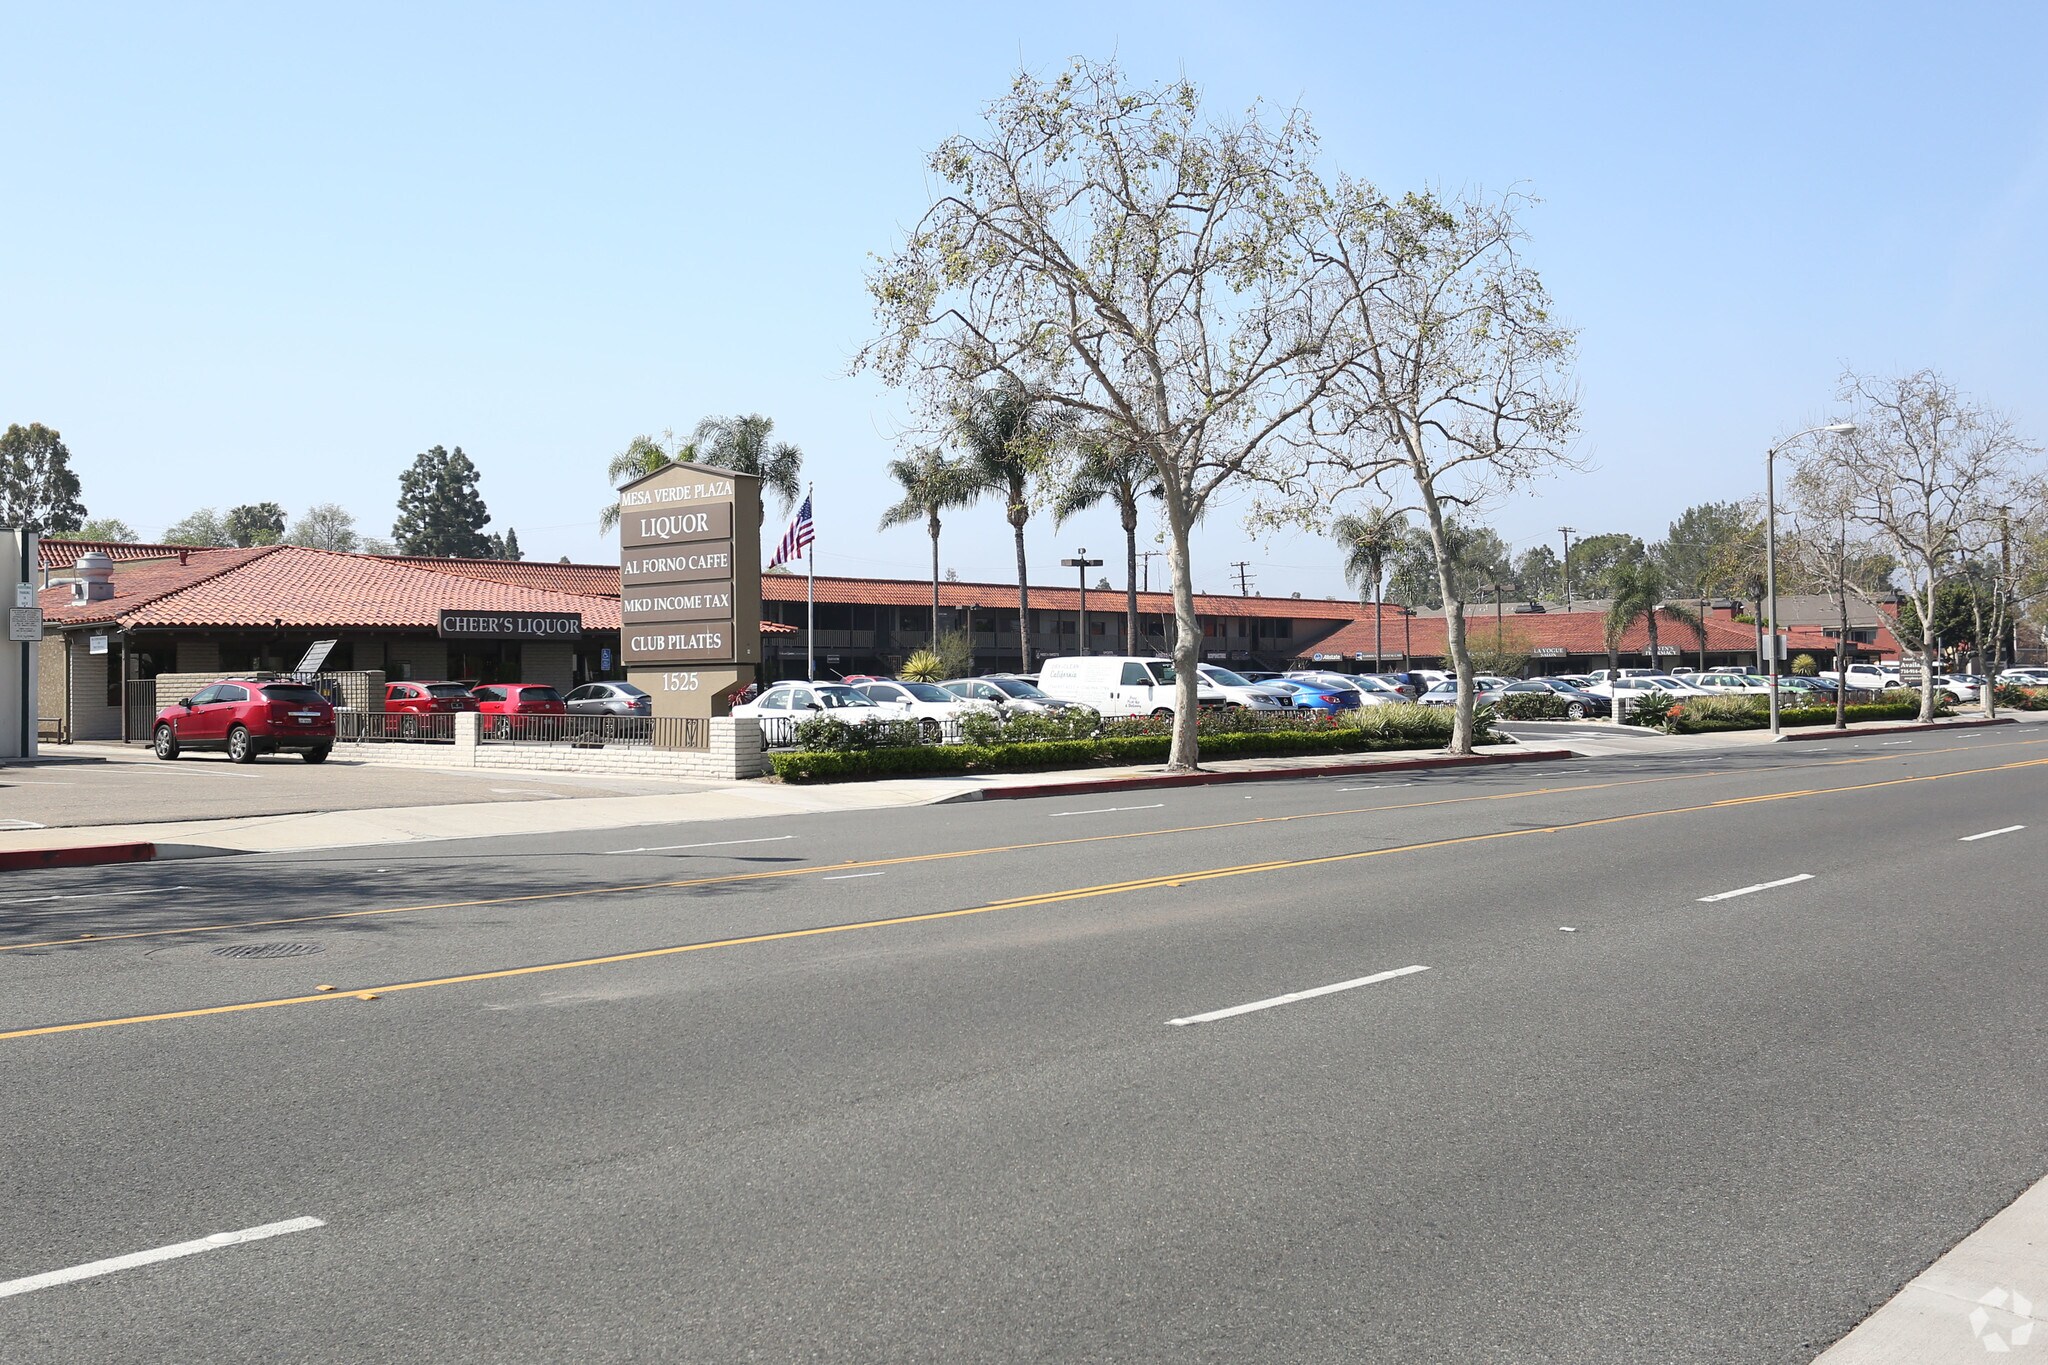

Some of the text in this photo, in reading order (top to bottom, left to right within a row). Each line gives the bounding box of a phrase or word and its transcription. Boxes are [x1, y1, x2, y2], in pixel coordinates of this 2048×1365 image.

[621, 480, 733, 507] MESA VERDE PLAZA
[640, 512, 709, 540] LIQUOR
[624, 553, 728, 575] AL FORNO CAFFE
[624, 593, 729, 613] MKD INCOME TAX
[443, 616, 581, 637] CHEER'S LIQUOR
[631, 633, 722, 652] CLUB PILATES
[662, 672, 699, 692] 1525
